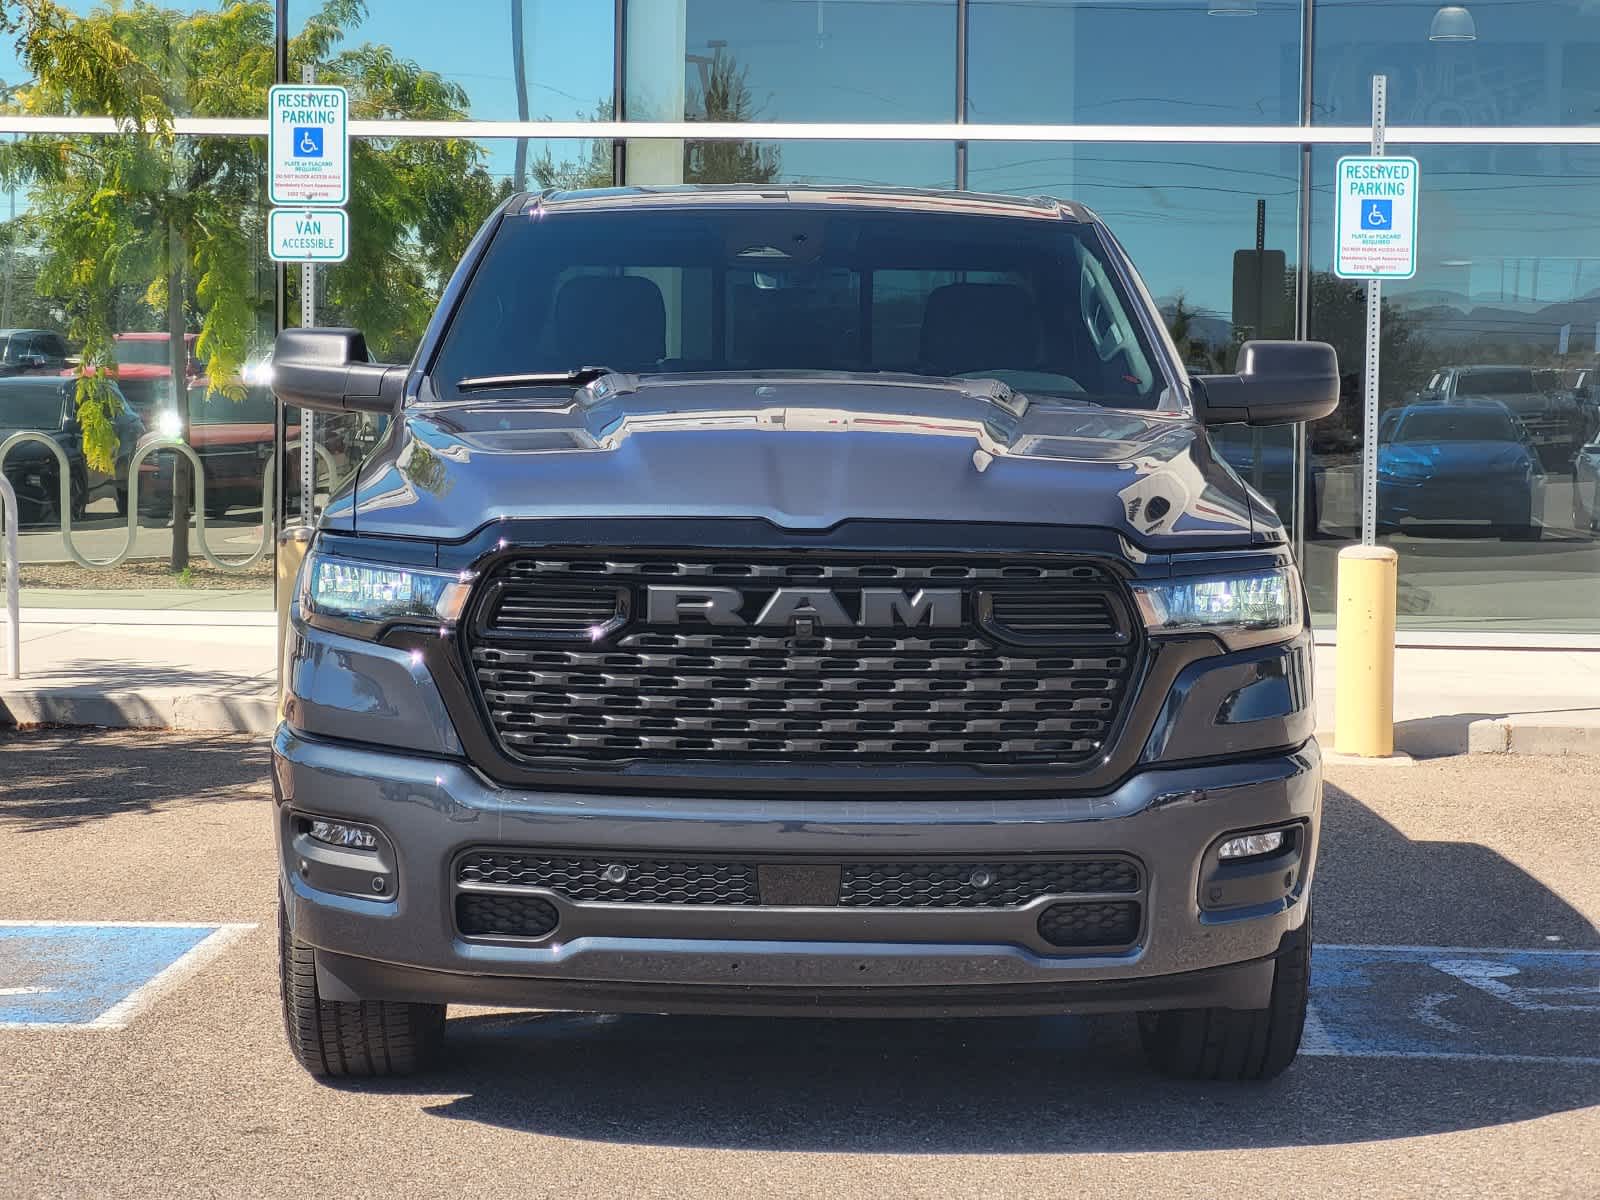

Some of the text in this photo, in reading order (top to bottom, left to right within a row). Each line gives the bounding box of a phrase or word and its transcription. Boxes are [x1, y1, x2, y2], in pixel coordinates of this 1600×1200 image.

[278, 94, 339, 108] RESERVED
[282, 111, 335, 124] PARKING
[1346, 165, 1409, 179] RESERVED
[1350, 182, 1405, 196] PARKING
[296, 220, 321, 234] VAN
[282, 238, 334, 248] ACCESSIBLE
[647, 585, 962, 627] RAM
